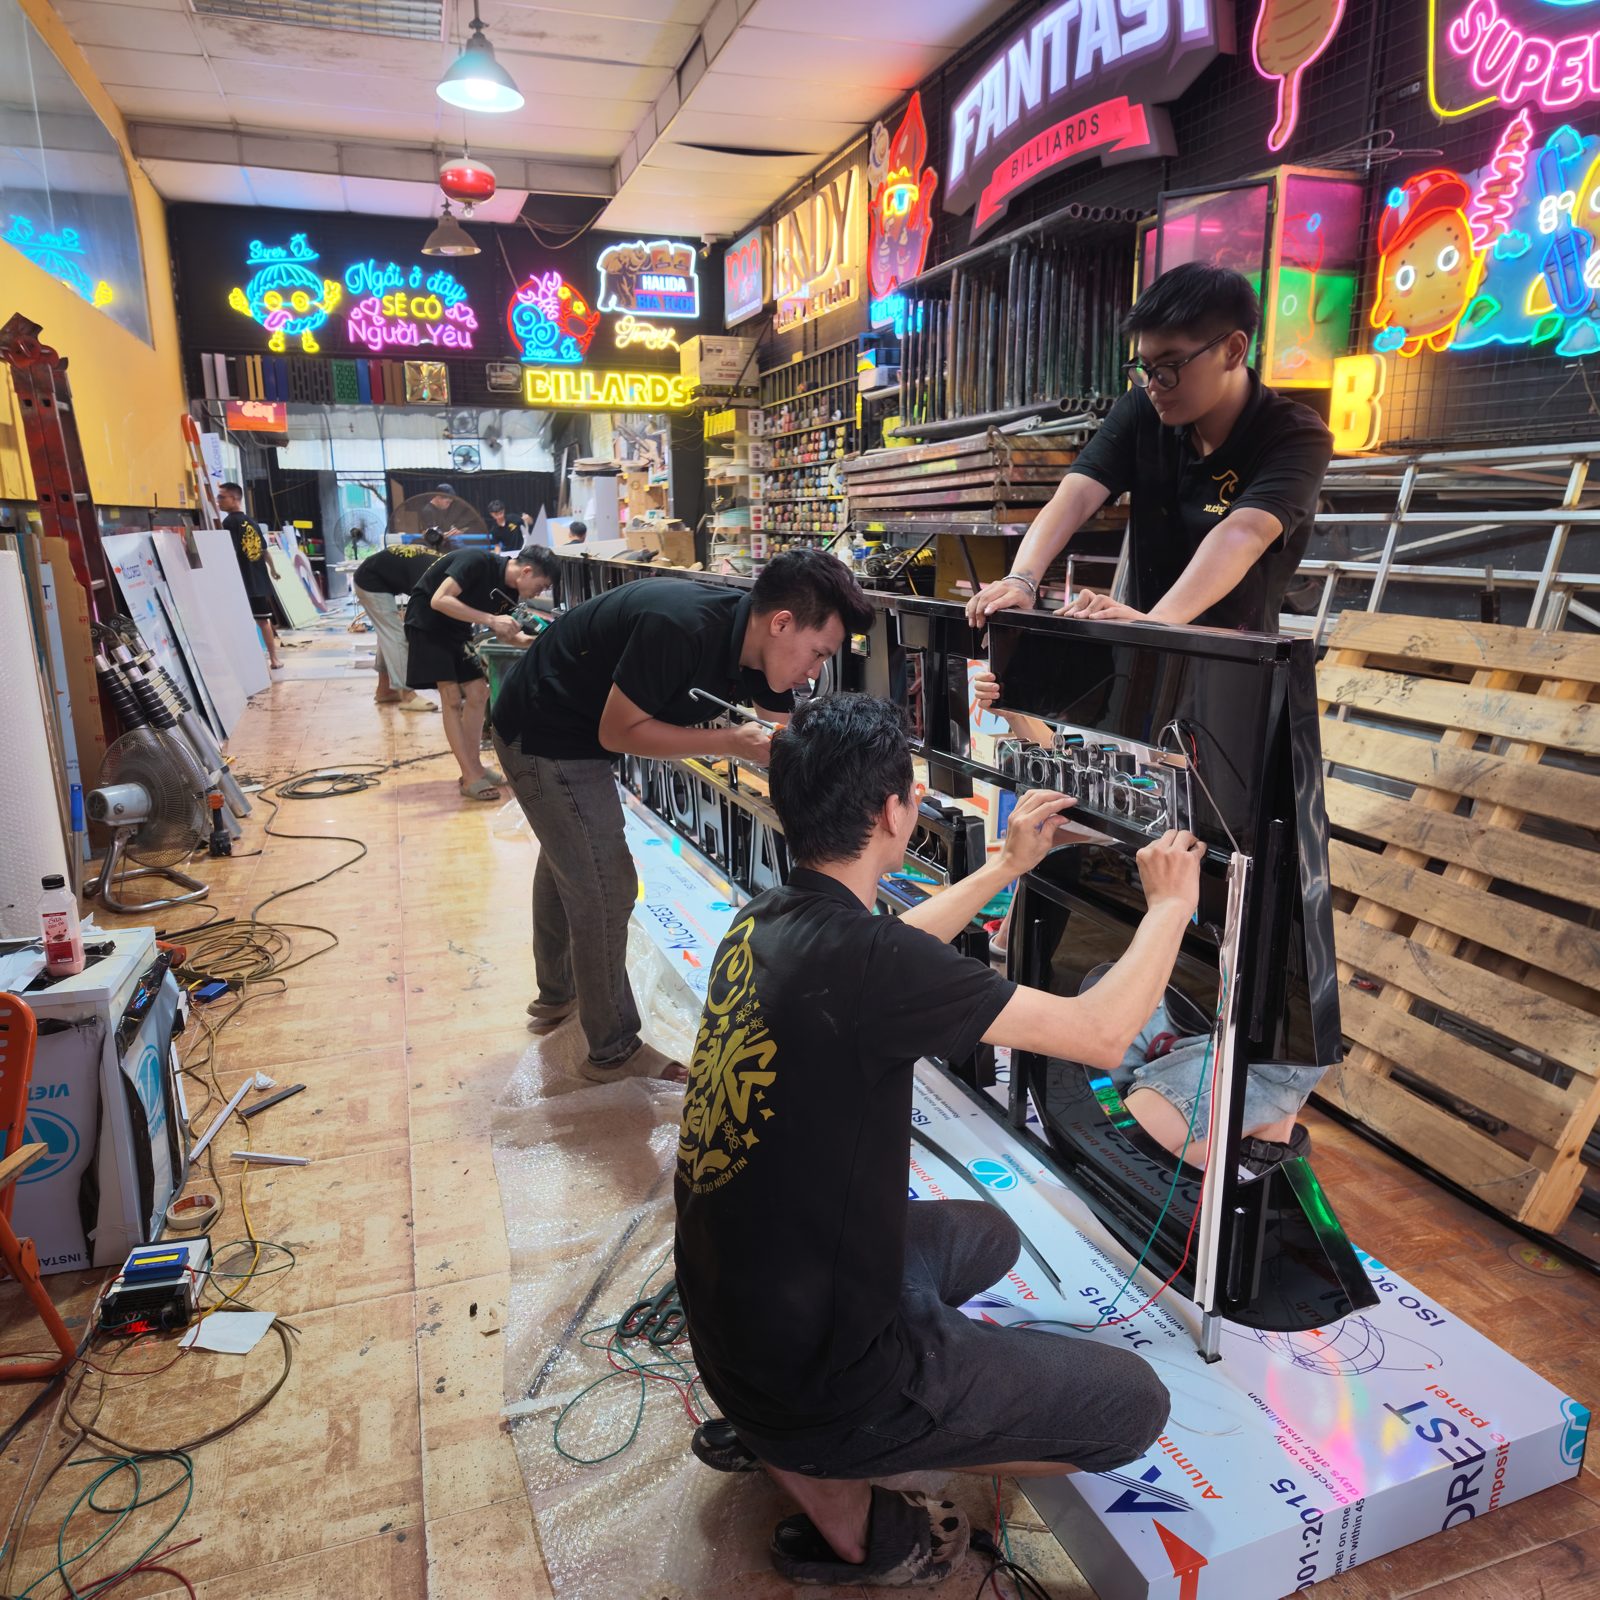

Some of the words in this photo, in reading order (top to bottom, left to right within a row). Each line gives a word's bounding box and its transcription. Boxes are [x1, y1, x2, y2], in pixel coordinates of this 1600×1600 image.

[1449, 0, 1600, 105] SUPE
[1010, 113, 1100, 179] BILLIARDS
[345, 258, 404, 299] Ngồi
[408, 264, 422, 289] ở
[425, 270, 468, 305] đây
[641, 275, 688, 292] HALIDA
[410, 293, 442, 320] CÓ
[636, 294, 661, 309] BIA
[347, 318, 420, 351] Người
[425, 322, 473, 348] Yêu
[526, 369, 694, 408] BILLARDS
[1075, 1230, 1114, 1265] installation
[1089, 1258, 1107, 1273] only
[1397, 1295, 1447, 1327] ISO
[1247, 1391, 1304, 1443] installation
[1424, 1384, 1491, 1429] panel
[1273, 1434, 1299, 1457] only
[1302, 1445, 1331, 1469] after
[1157, 1435, 1224, 1499] Alumin
[1298, 1457, 1349, 1505] direction
[1329, 1468, 1360, 1497] days
[1341, 1506, 1352, 1530] one
[1354, 1497, 1366, 1513] 45
[1338, 1530, 1348, 1548] on
[1349, 1515, 1363, 1552] within
